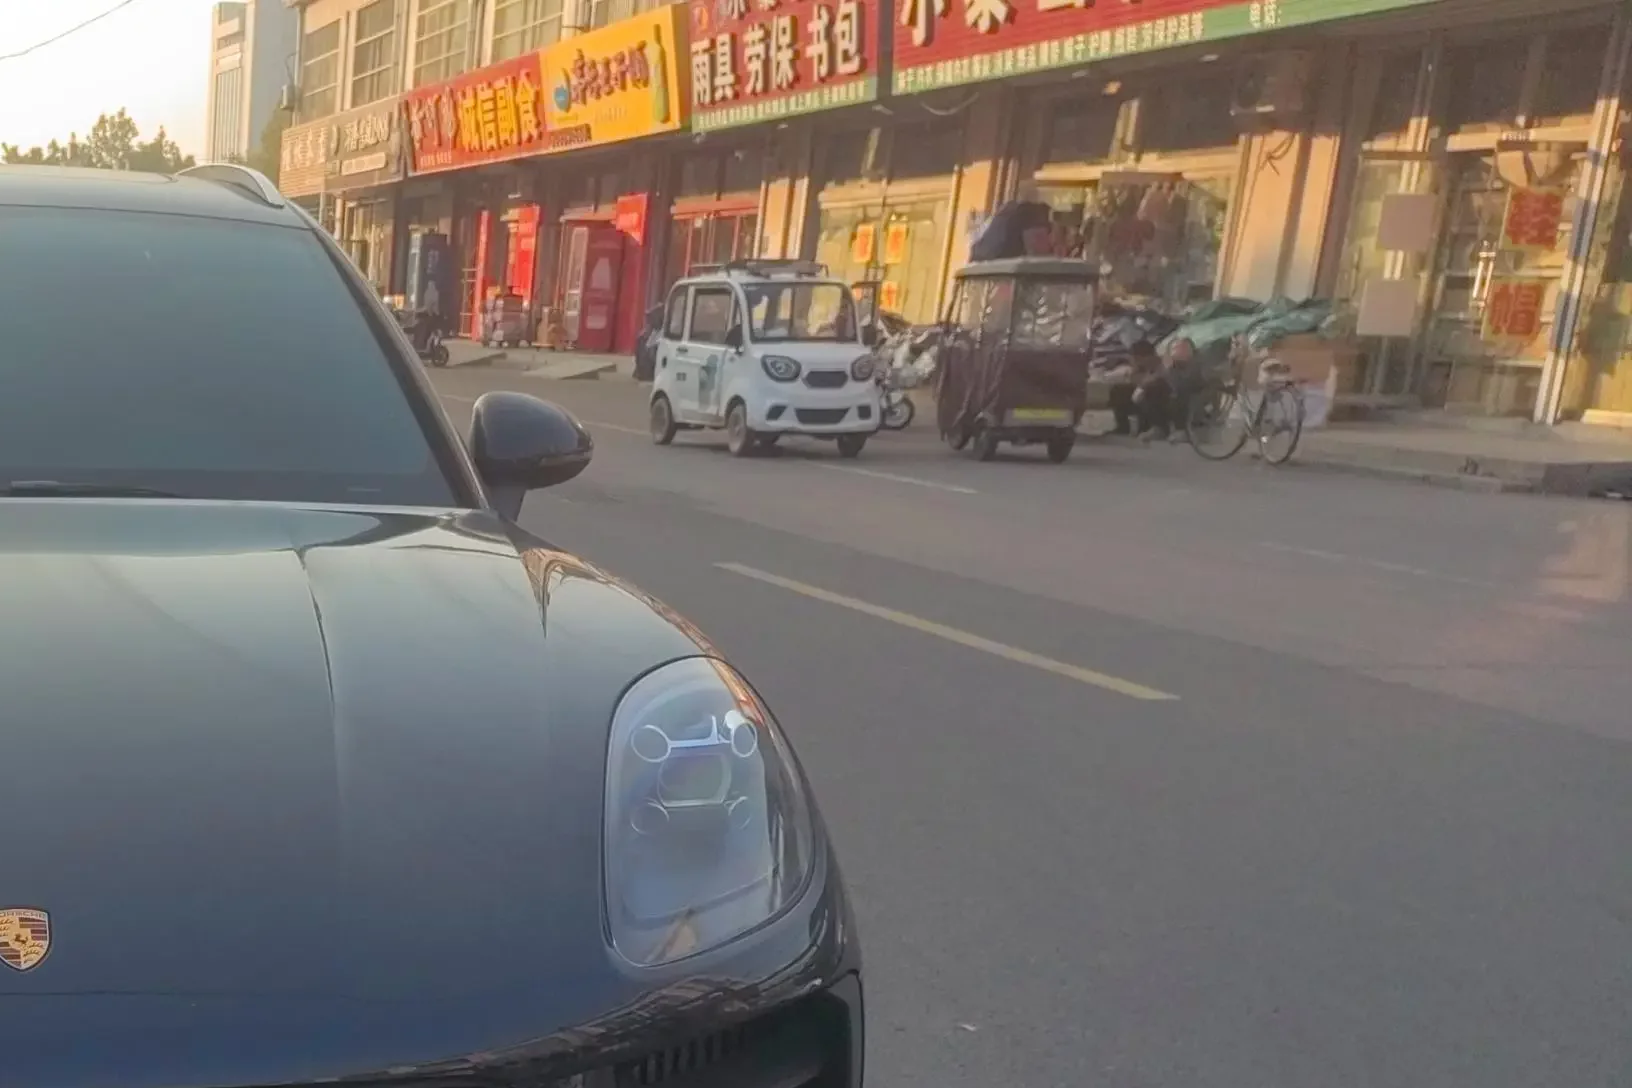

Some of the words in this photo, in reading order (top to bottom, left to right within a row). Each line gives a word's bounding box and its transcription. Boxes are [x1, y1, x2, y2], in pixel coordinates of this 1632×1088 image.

[691, 33, 735, 106] 雨具
[743, 16, 795, 94] 劳保
[805, 0, 860, 82] 书包
